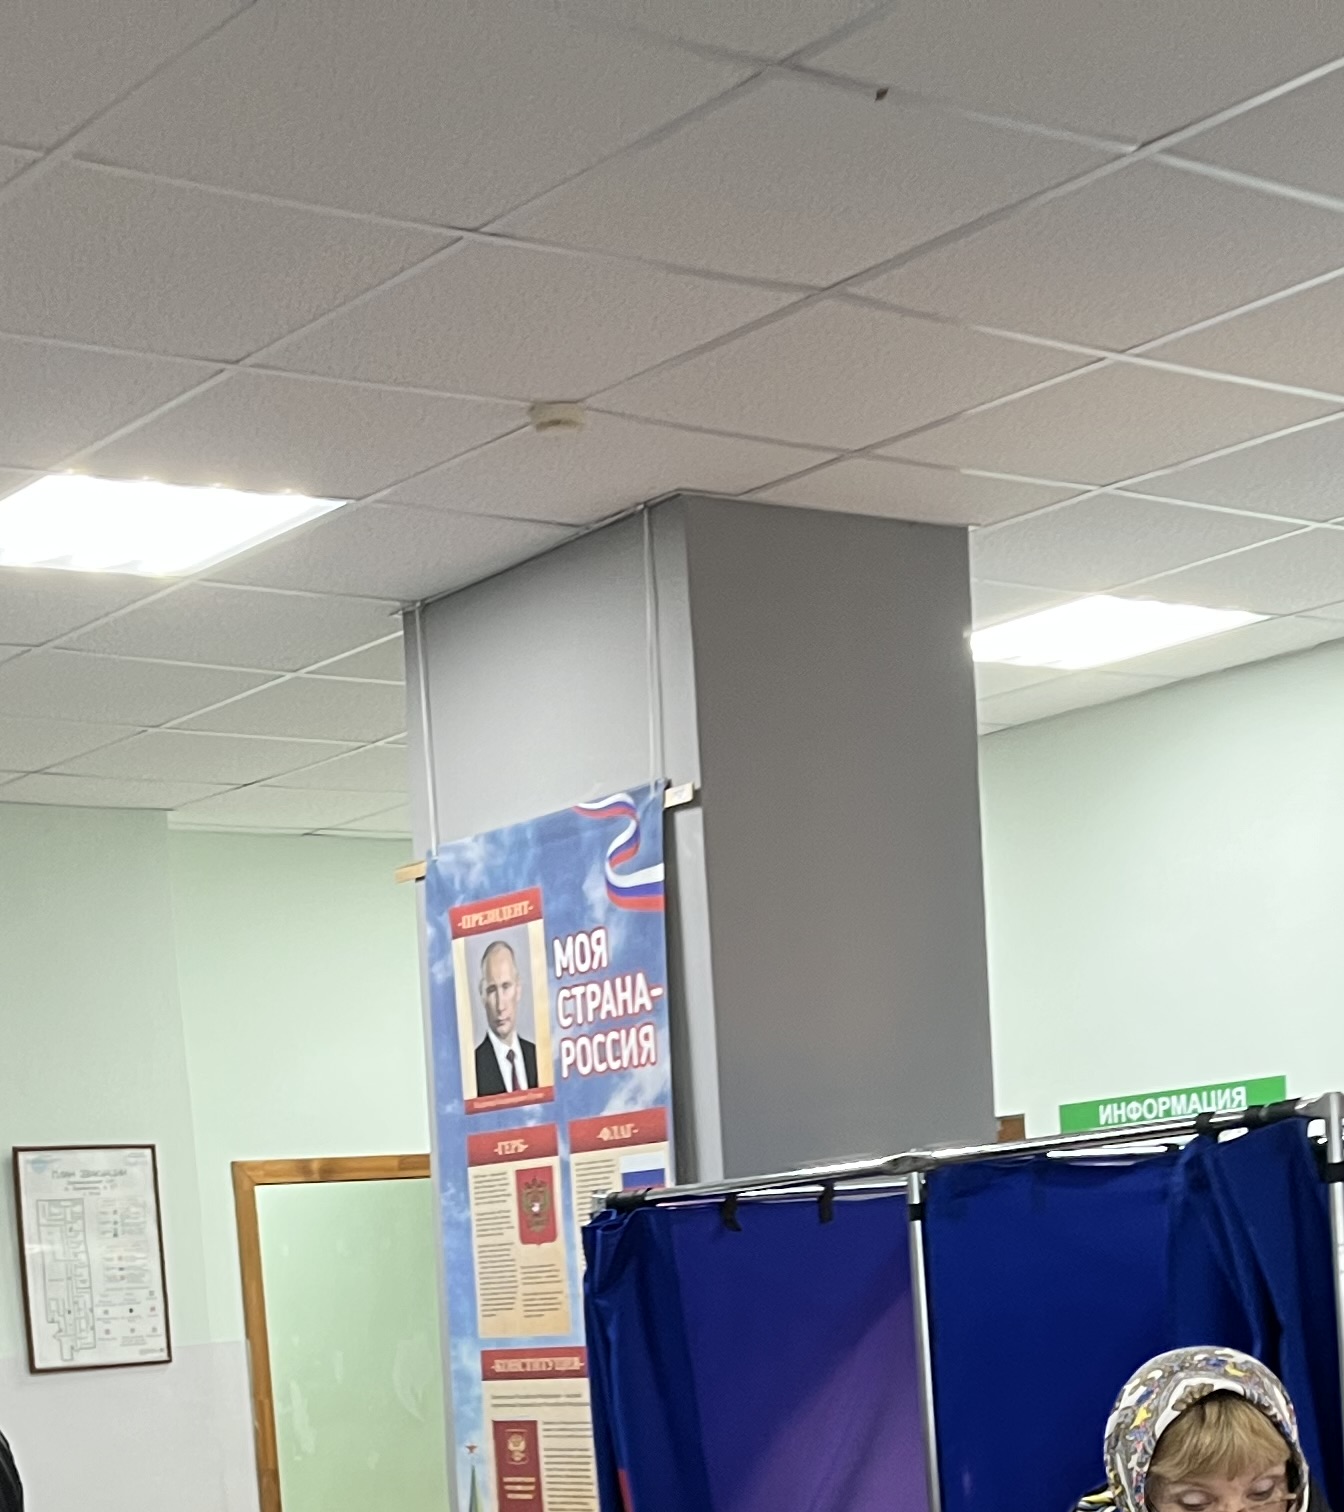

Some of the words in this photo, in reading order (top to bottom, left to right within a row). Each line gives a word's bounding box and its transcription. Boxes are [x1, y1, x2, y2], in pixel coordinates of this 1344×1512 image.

[554, 927, 608, 978] МОЯ
[560, 1024, 656, 1079] РОССИЯ
[1098, 1086, 1247, 1126] ИНФОРМАЦИЯ
